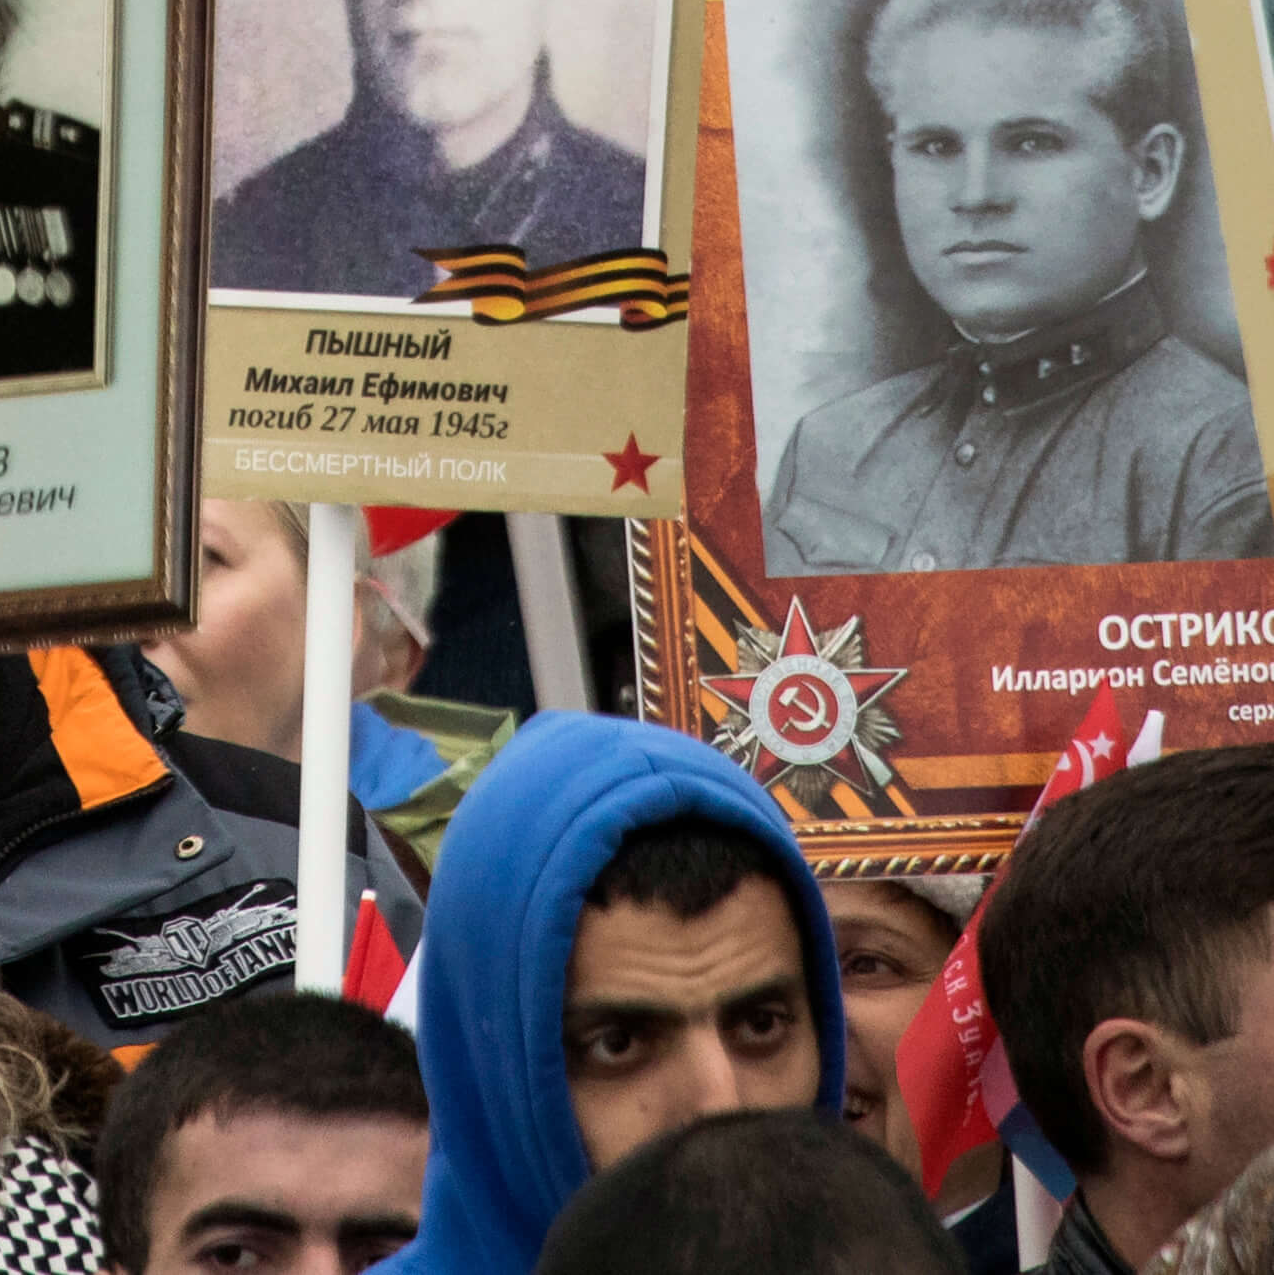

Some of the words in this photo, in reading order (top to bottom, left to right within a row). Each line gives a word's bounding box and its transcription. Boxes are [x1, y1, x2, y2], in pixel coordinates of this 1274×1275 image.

[305, 328, 451, 361] ПЫШНЫЙ
[244, 367, 353, 397] Михаил
[361, 372, 508, 405] Ефимович
[227, 404, 313, 431] погиб
[320, 406, 356, 433] 27
[361, 414, 419, 437] мая
[431, 409, 509, 440] 1945г
[234, 447, 432, 479] БЕССМЕРТНЫЙ
[438, 457, 507, 483] ПОЛК
[992, 665, 1144, 696] Илларион
[101, 972, 204, 1018] WORLD
[219, 925, 298, 982] TANK
